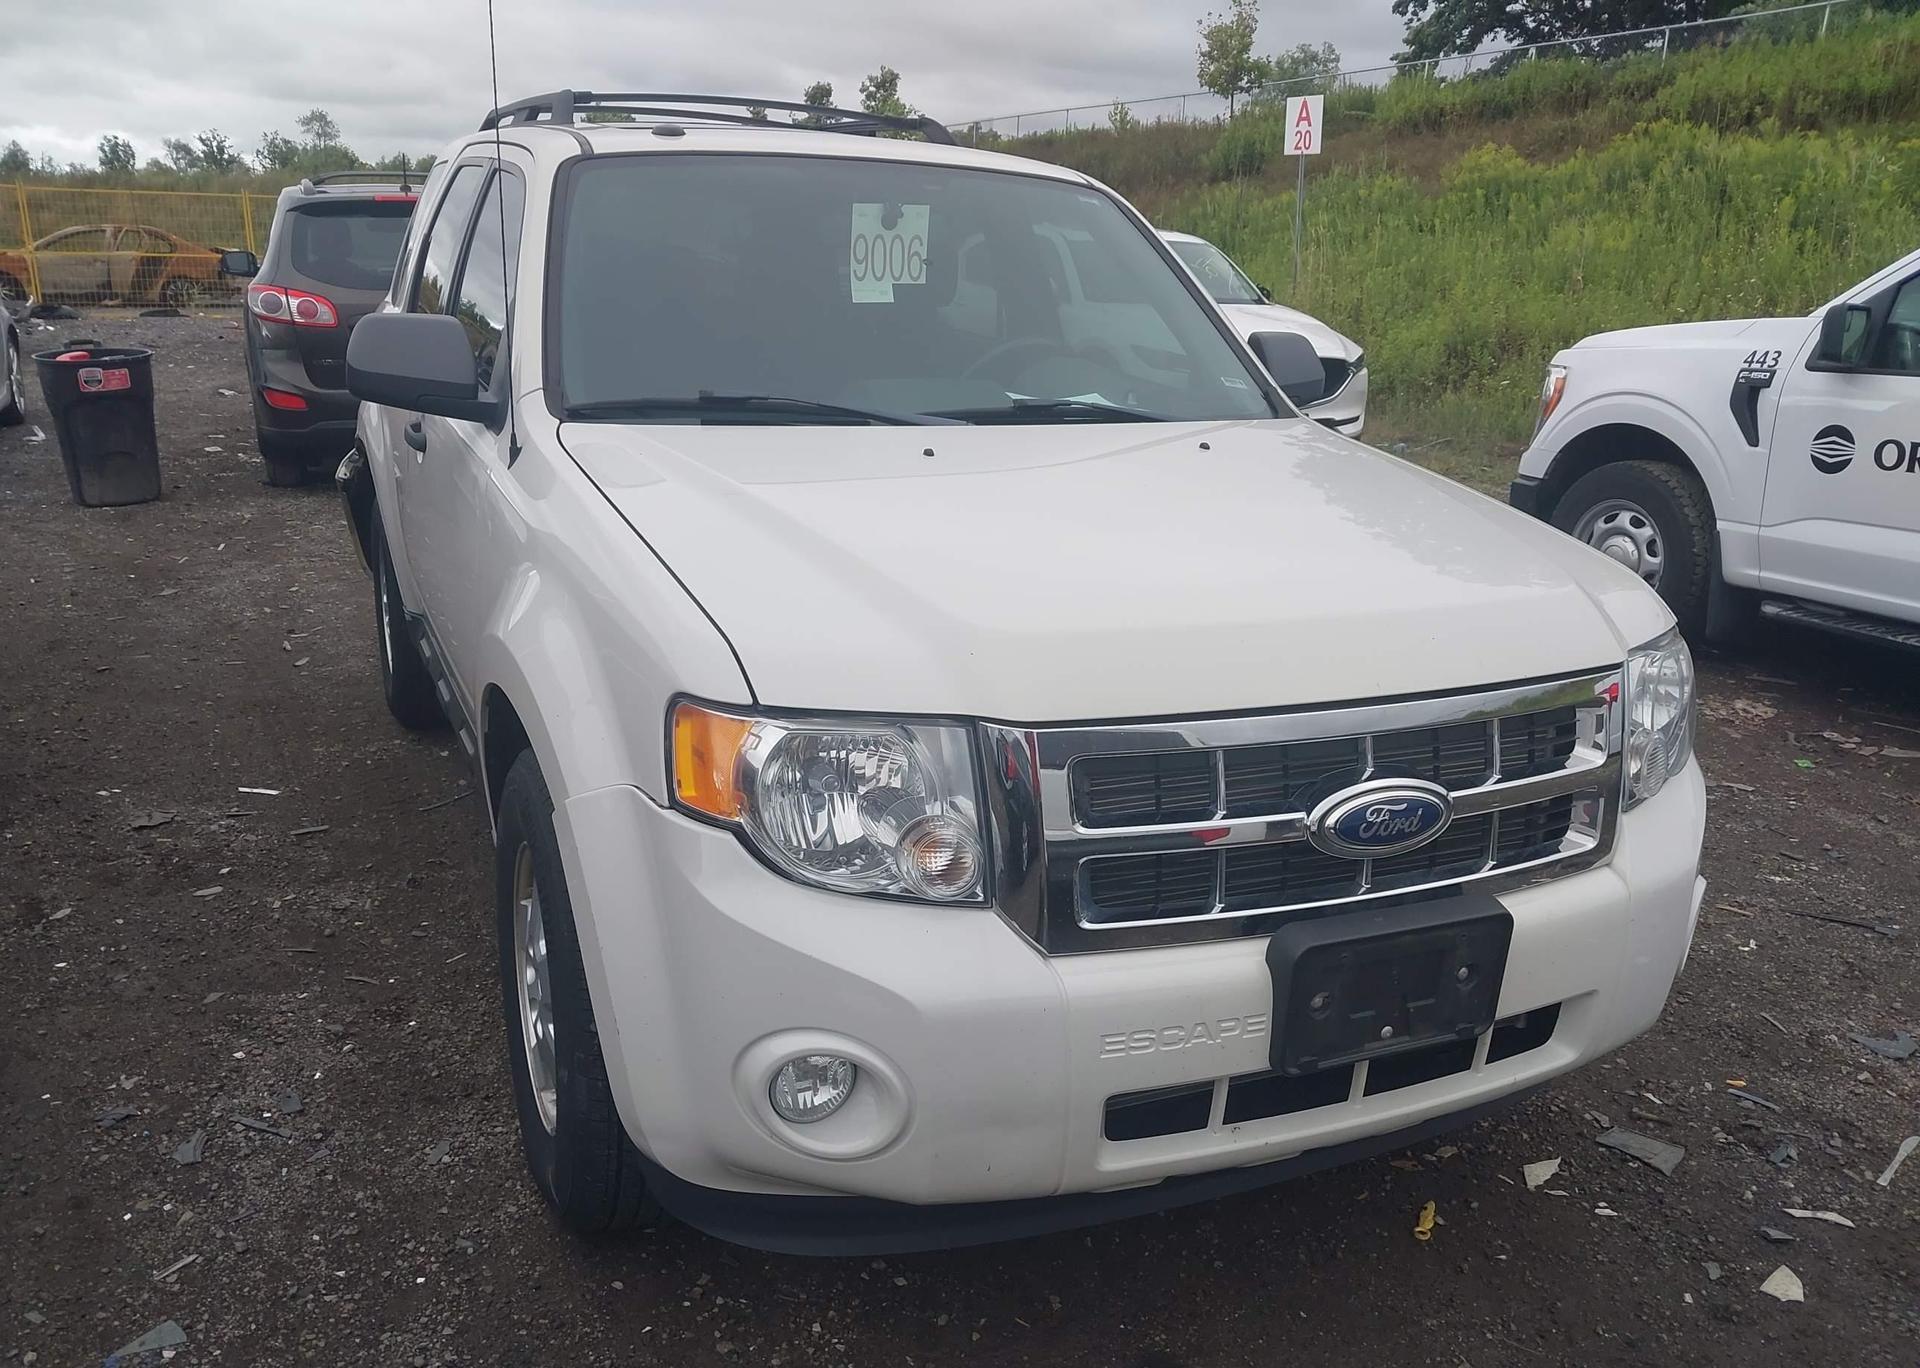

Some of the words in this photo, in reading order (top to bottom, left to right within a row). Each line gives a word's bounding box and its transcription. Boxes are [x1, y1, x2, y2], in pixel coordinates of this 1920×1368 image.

[1296, 98, 1311, 127] A
[1294, 130, 1311, 150] 20
[853, 233, 923, 281] 9006
[1743, 350, 1782, 368] 443
[1739, 371, 1771, 379] F-150
[1359, 802, 1423, 839] Ford
[1100, 1013, 1267, 1058] ESCAPE
